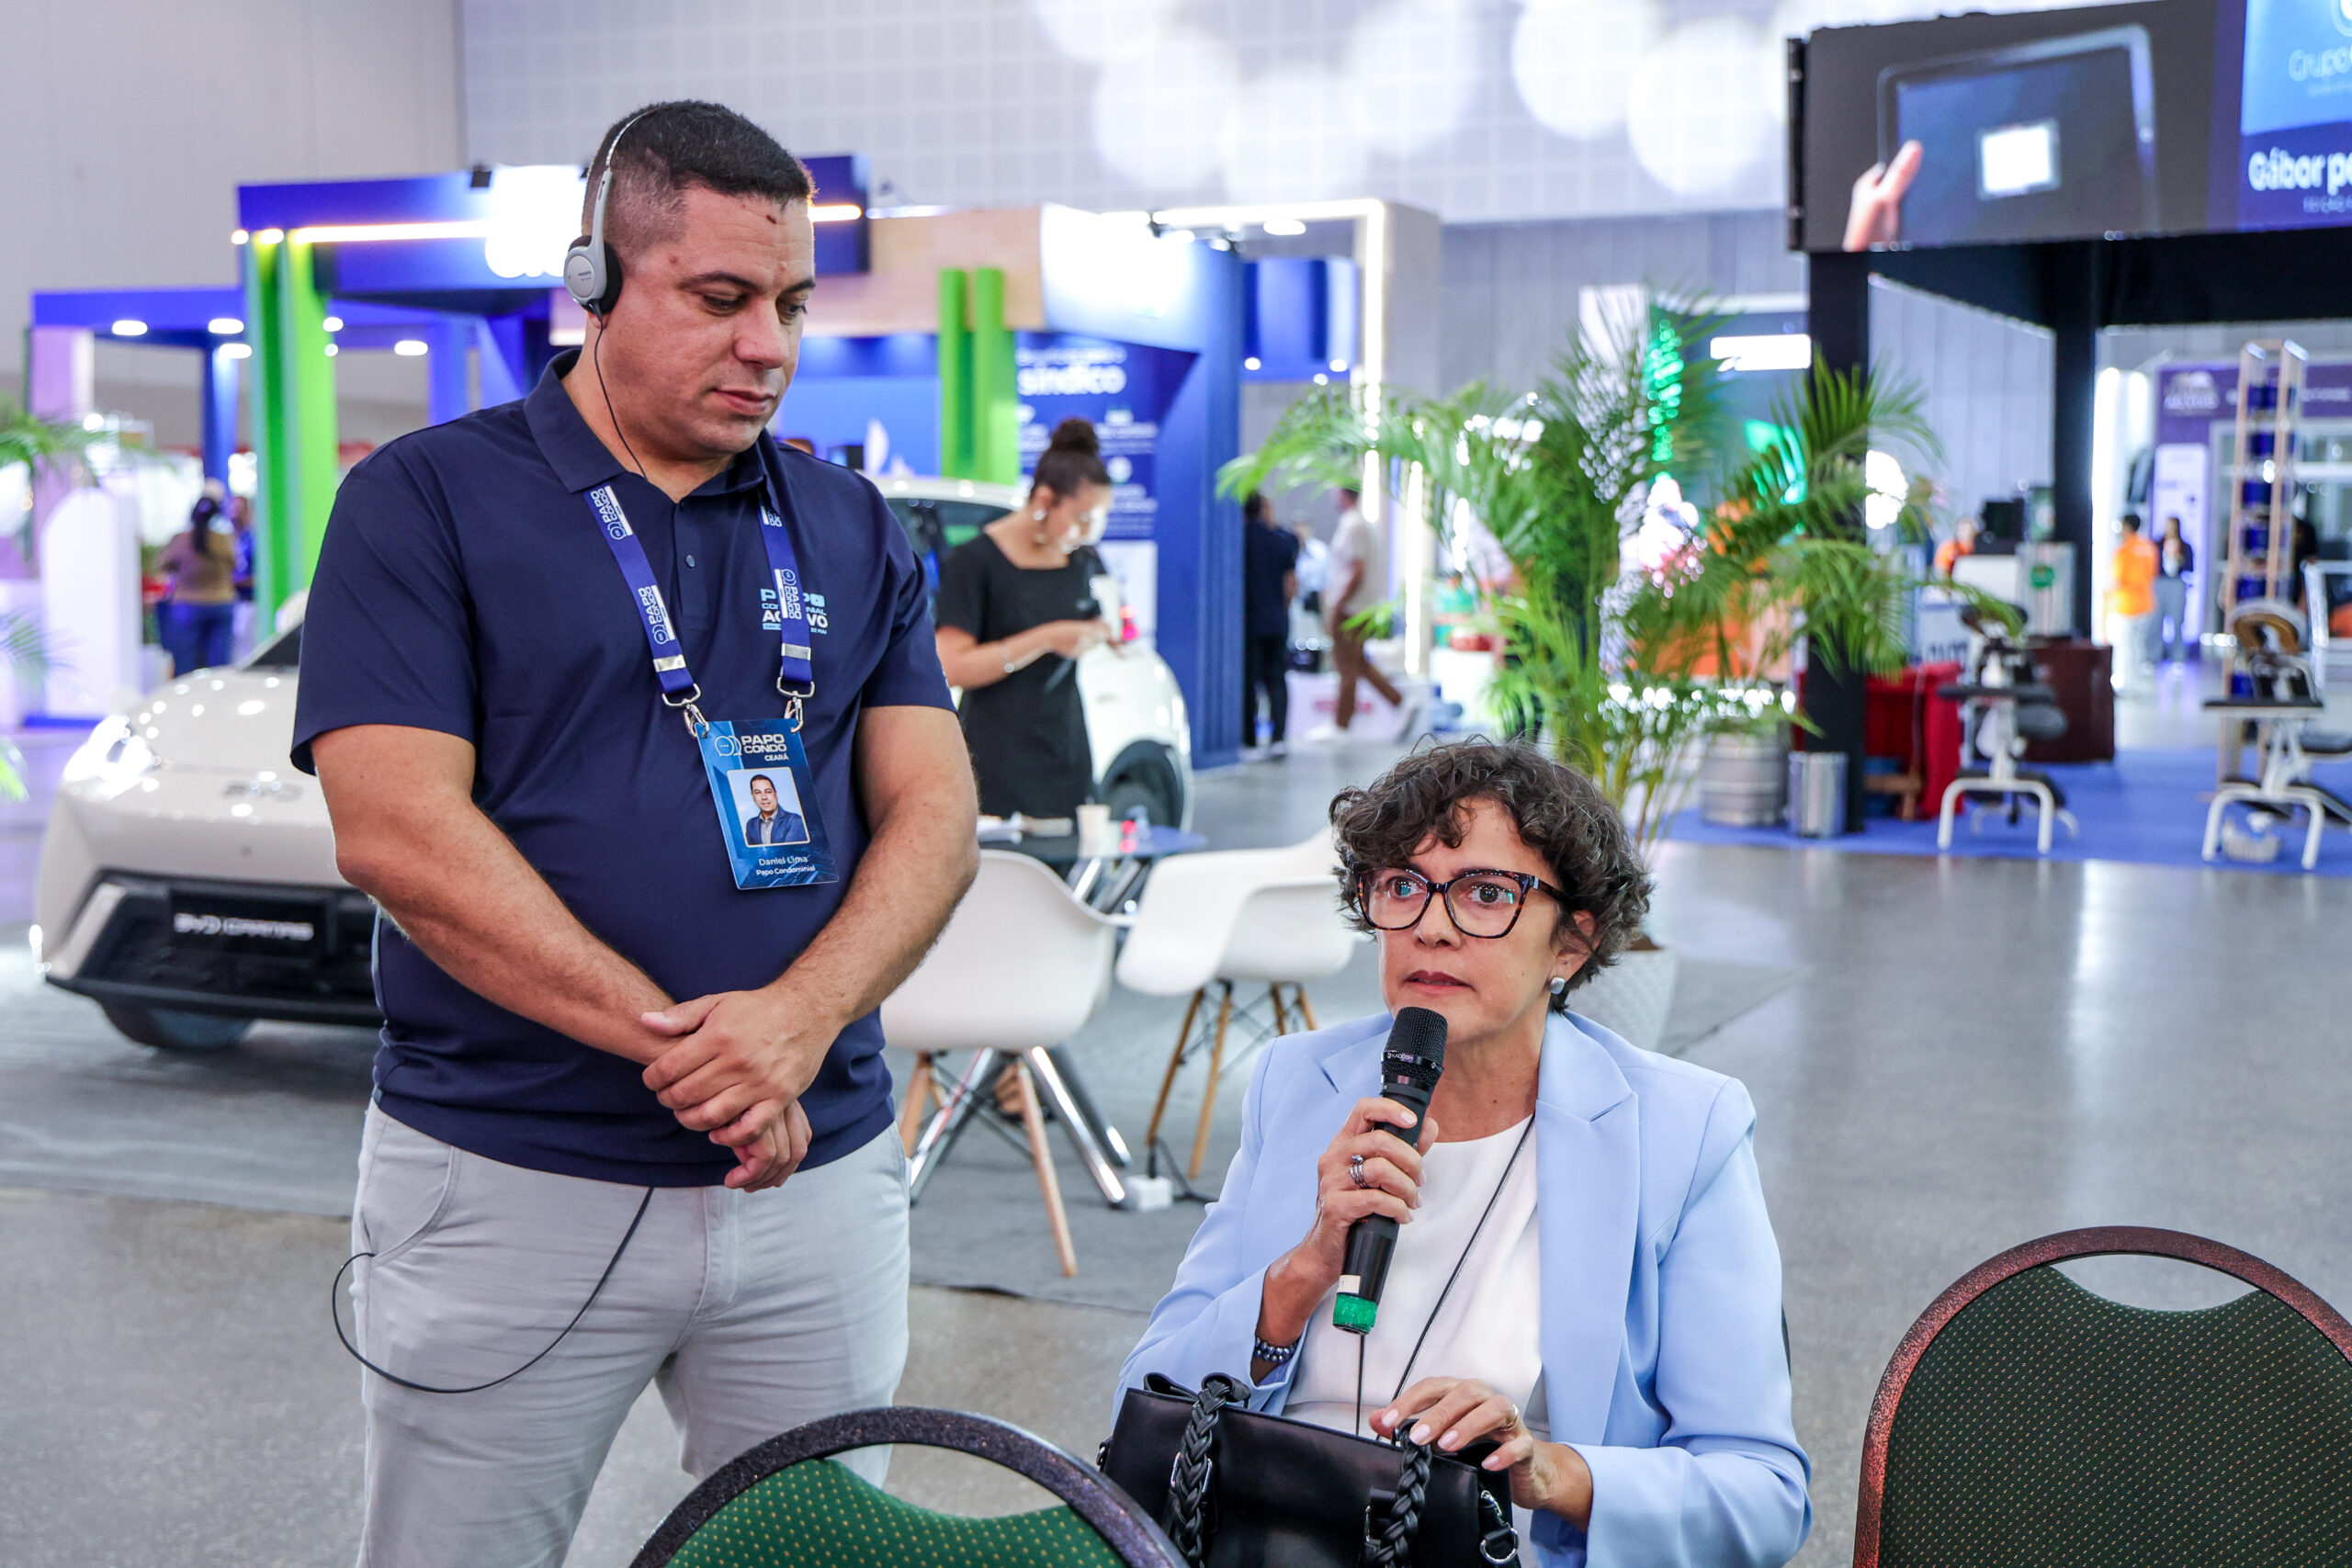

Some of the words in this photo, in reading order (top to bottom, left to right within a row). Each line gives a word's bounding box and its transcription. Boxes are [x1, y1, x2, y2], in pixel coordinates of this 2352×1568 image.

[590, 491, 613, 523] PAPO
[597, 488, 618, 521] CONDO
[638, 588, 657, 625] PAPO
[645, 586, 662, 623] CONDO
[784, 585, 795, 619] CONDO
[790, 586, 802, 620] PAPO
[741, 734, 785, 745] PAPO
[744, 744, 787, 753] CONDO
[764, 752, 789, 761] CEARÁ
[758, 856, 786, 866] Daniel
[786, 855, 808, 863] Lima
[775, 864, 816, 874] Condominial
